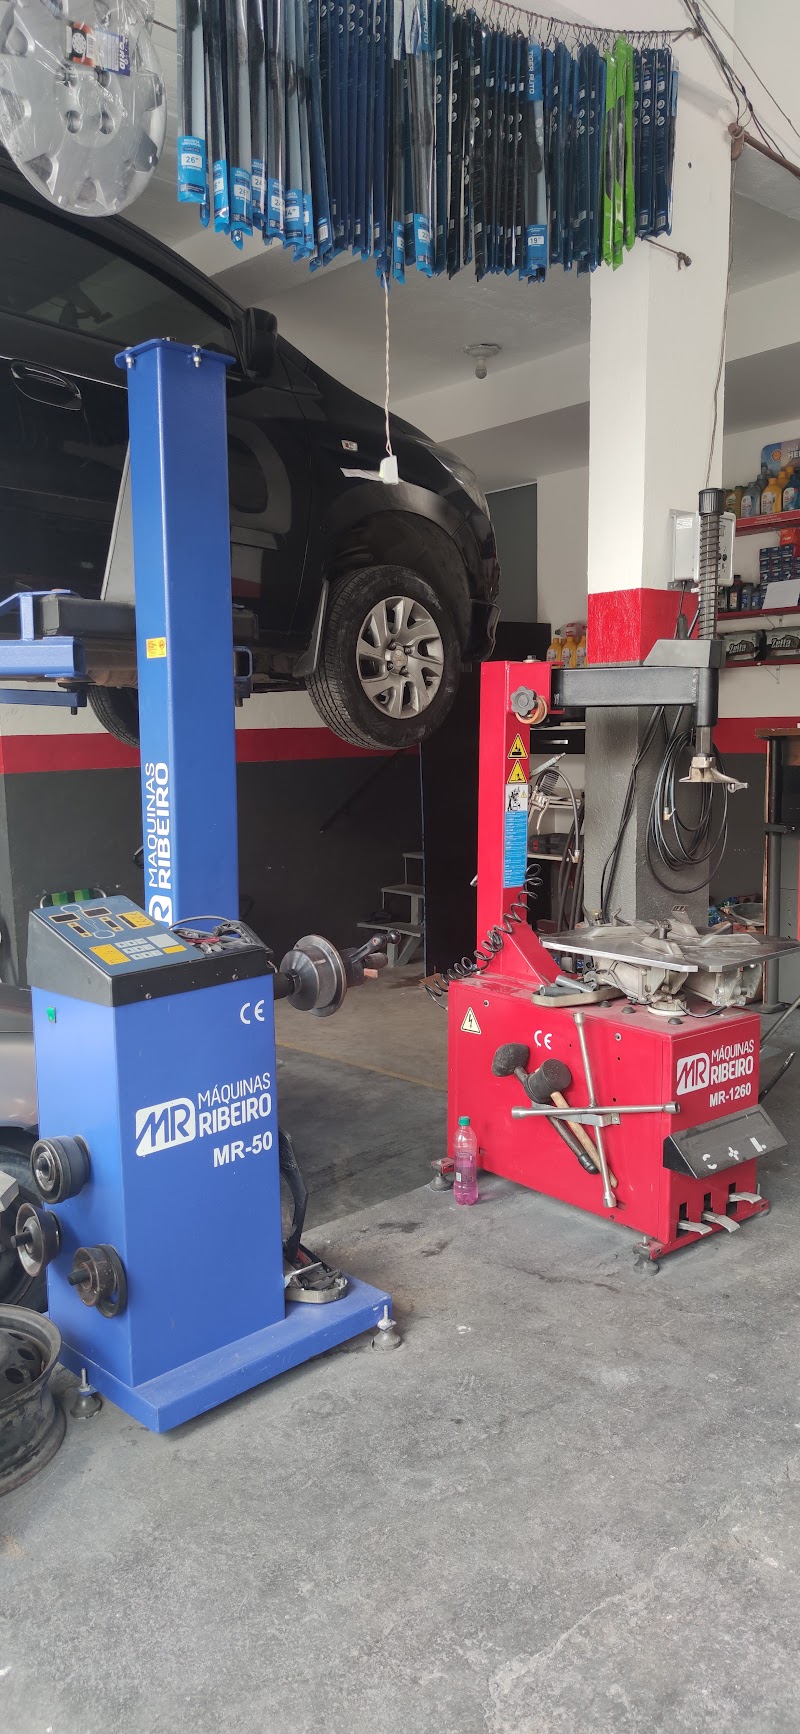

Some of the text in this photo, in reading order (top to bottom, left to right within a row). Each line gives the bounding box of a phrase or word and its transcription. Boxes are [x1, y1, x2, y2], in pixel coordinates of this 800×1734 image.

[155, 762, 171, 890] RIBEIRO
[710, 1055, 754, 1086] RIBEIRO
[711, 1039, 755, 1064] MÁQUINAS
[197, 1072, 271, 1110] MÁQUINAS
[677, 1055, 708, 1092] MR
[709, 1082, 752, 1108] MR-1260
[136, 1101, 192, 1150] MR
[199, 1092, 272, 1138] RIBEIRO
[213, 1130, 273, 1168] MR-50
